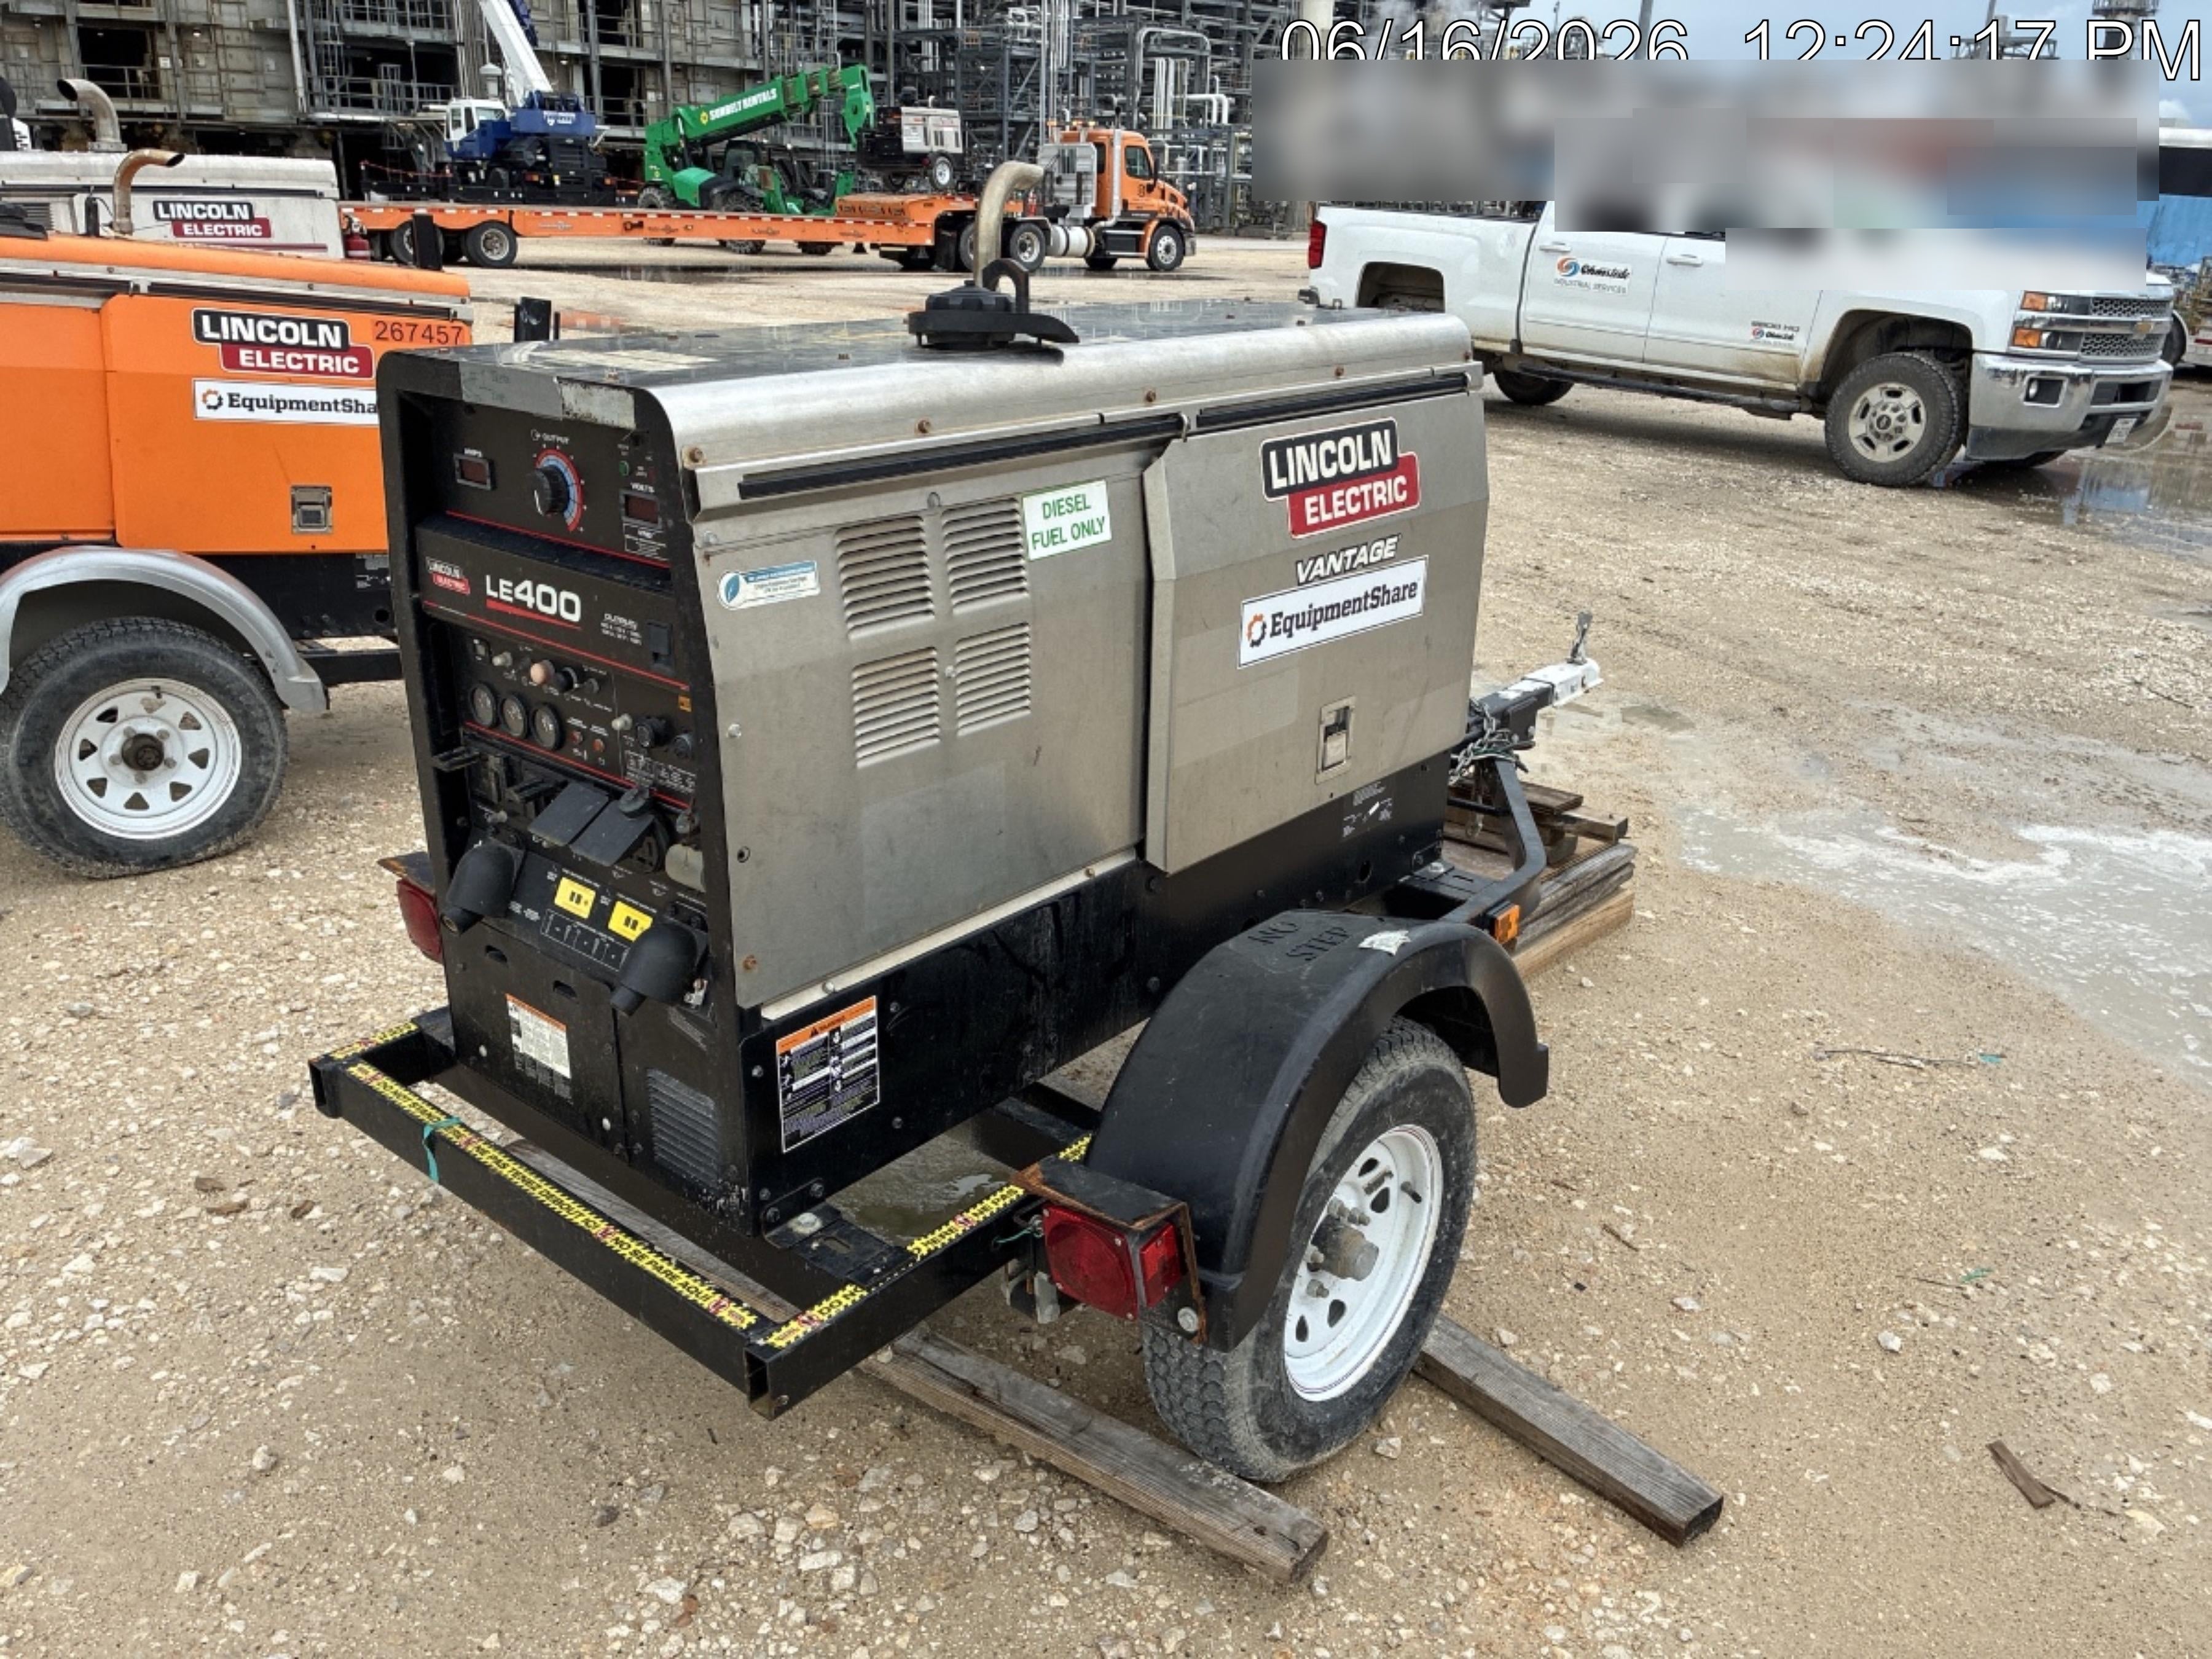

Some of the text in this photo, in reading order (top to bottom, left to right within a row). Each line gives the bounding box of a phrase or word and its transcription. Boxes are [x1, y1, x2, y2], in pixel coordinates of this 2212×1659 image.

[157, 202, 250, 220] LINCOLN
[183, 222, 263, 237] ELECTRIC
[201, 314, 342, 349] LINCOLN
[374, 320, 463, 346] 267457
[238, 348, 360, 374] ELECTRIC
[227, 392, 377, 416] EquipmentSha
[1269, 429, 1392, 490] LINCOLN
[1041, 493, 1092, 520] DIESEL
[1304, 475, 1408, 526] ELECTRIC
[1031, 516, 1105, 551] FUEL ONLY
[1295, 533, 1400, 586] VANTAGE
[485, 574, 582, 623] LE400
[1269, 581, 1418, 639] EquipmentShare
[1285, 925, 1351, 962] STEP
[612, 1236, 631, 1251] NO
[645, 1259, 683, 1284] PARE
